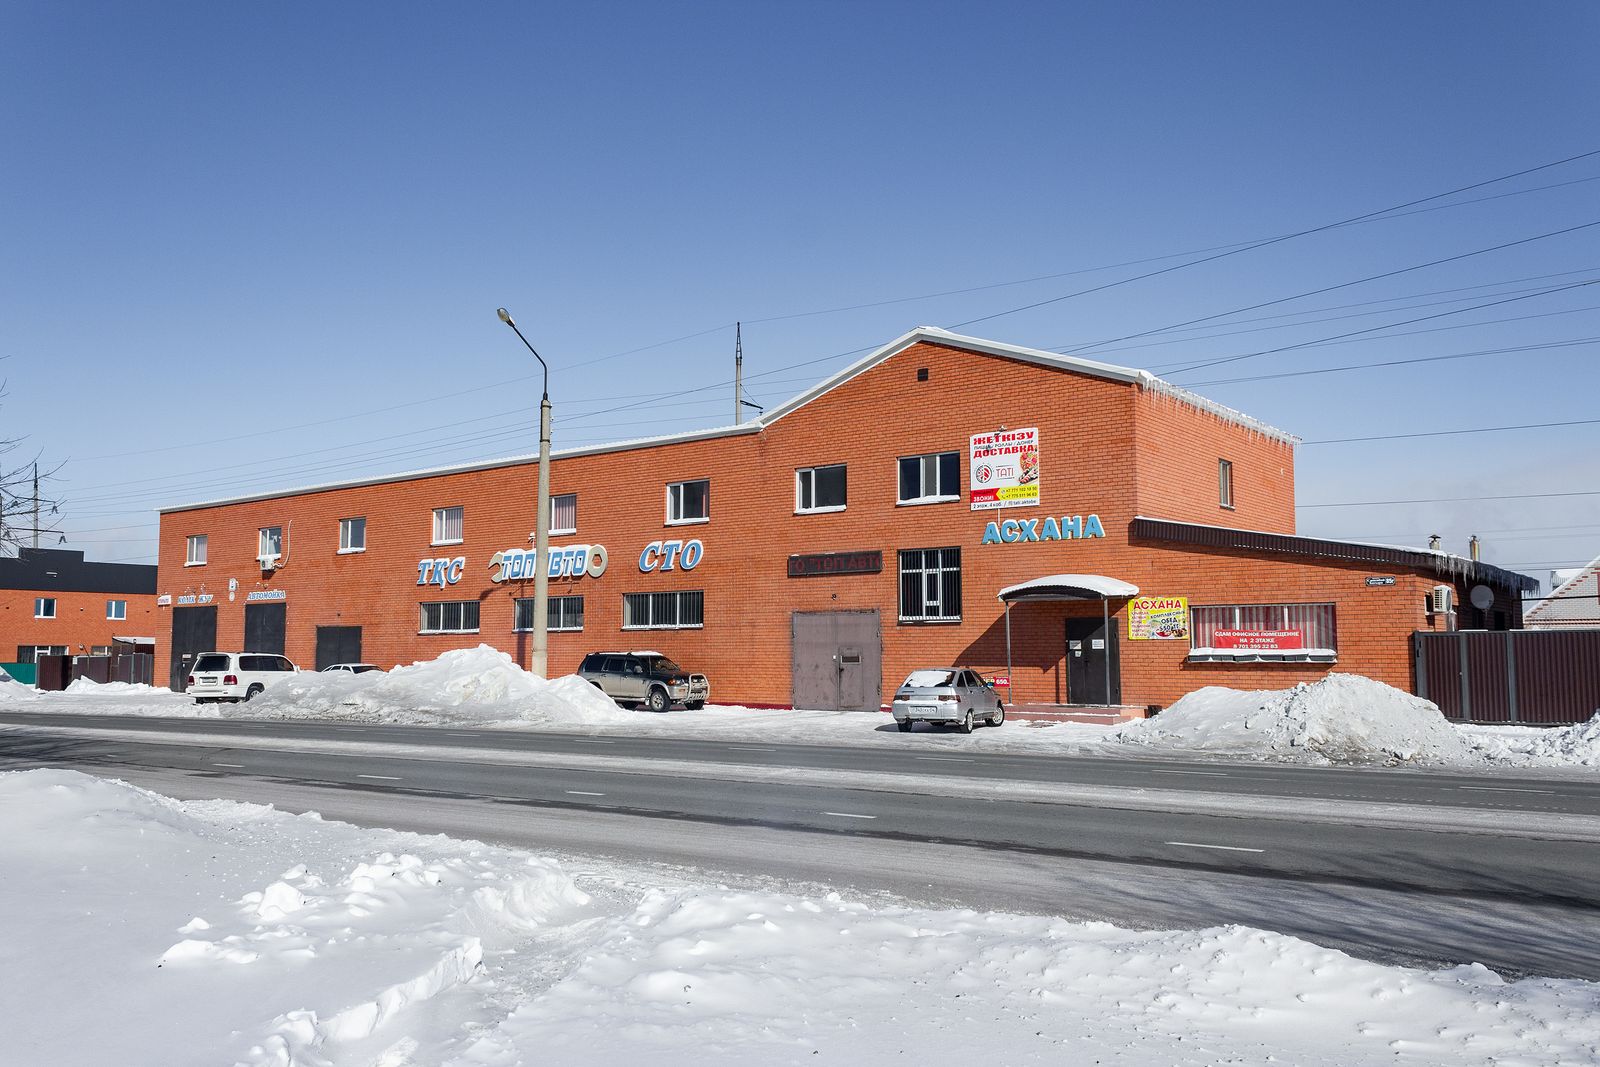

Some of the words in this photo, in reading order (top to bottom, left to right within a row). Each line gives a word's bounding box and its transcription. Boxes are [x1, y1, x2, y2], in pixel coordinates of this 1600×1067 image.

[974, 445, 1034, 459] ДОСТАВКА
[996, 467, 1014, 477] TATI
[981, 514, 1105, 544] АСХАНА
[638, 539, 704, 572] СТО
[417, 556, 465, 589] ТҚС
[1133, 600, 1181, 609] АСХАНА
